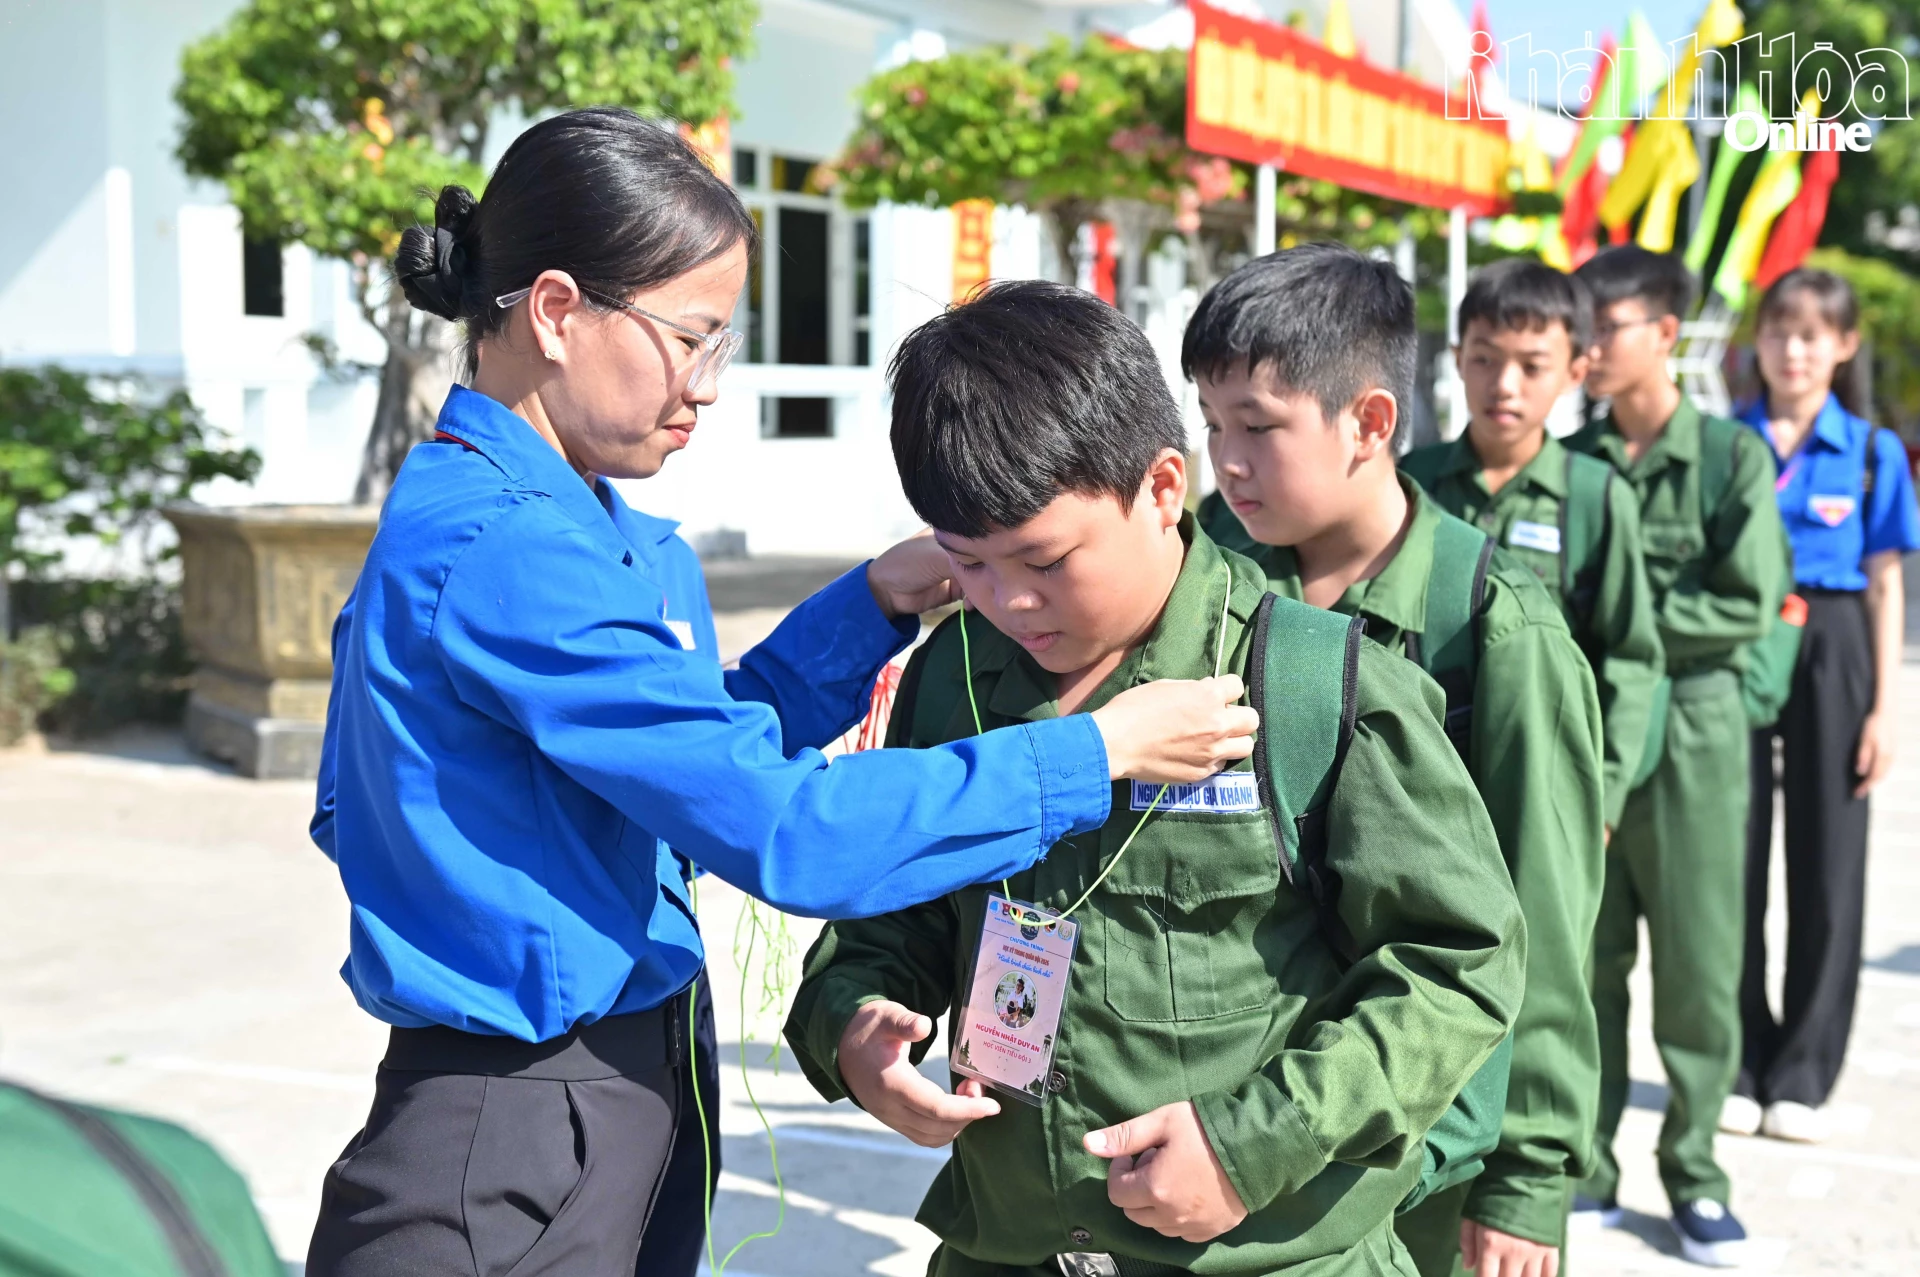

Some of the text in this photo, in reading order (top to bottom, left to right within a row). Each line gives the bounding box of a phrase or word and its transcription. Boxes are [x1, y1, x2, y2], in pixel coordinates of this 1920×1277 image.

[1203, 786, 1219, 805] GIA
[1219, 781, 1253, 806] KHÁNH
[1009, 936, 1044, 952] CHƯƠNG TRÌNH
[975, 1023, 1040, 1053] NGUYỄN NHẬT DUY AN
